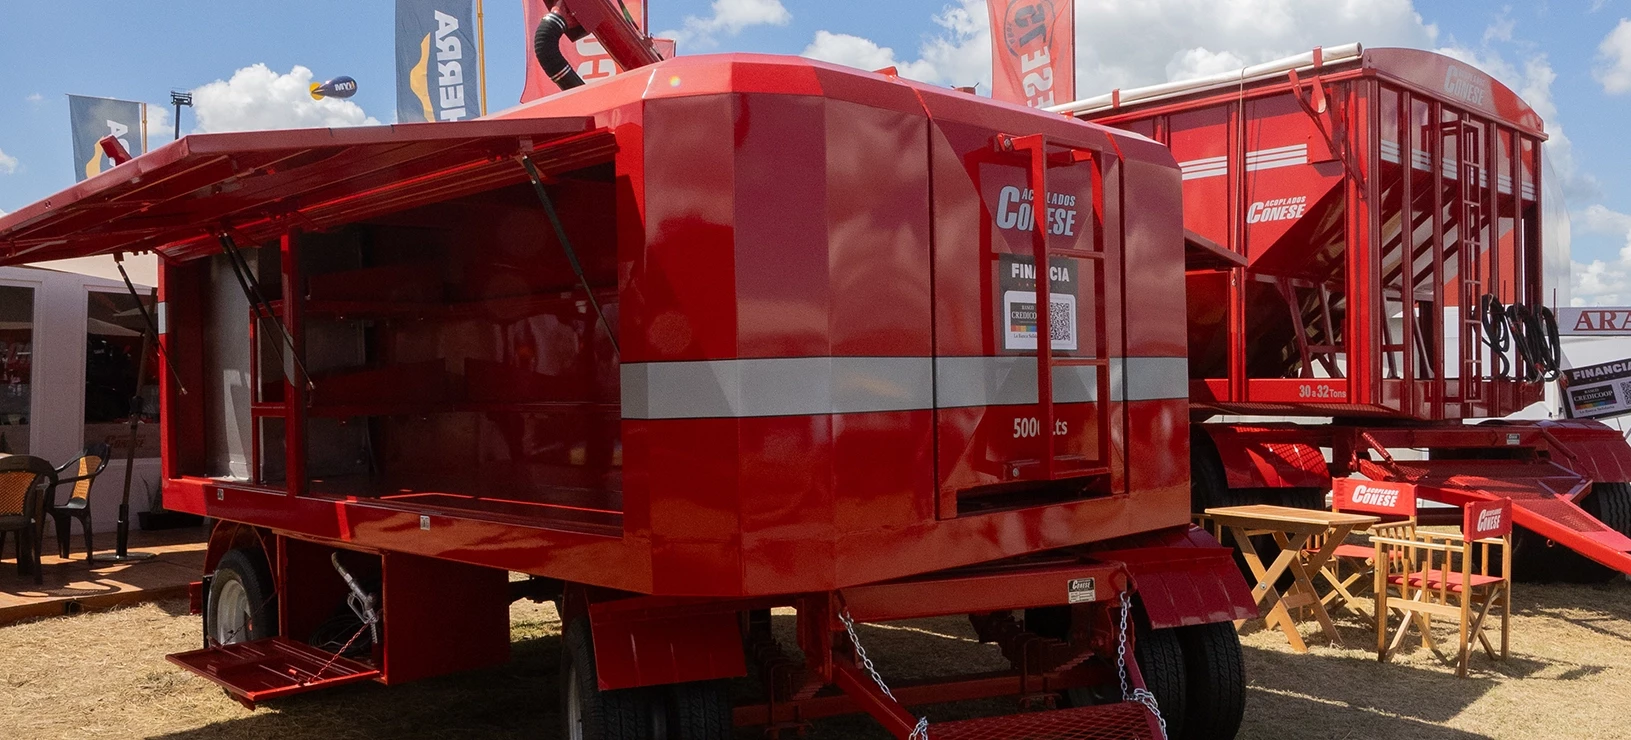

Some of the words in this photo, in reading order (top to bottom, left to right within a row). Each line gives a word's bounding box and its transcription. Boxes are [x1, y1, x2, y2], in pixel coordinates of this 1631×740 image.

[1021, 188, 1076, 207] ACLADOS
[1265, 196, 1306, 207] ACOPLADOS
[996, 185, 1077, 236] COESE
[1246, 201, 1307, 224] CONESE
[1011, 263, 1070, 282] FINCIA
[1299, 384, 1311, 398] 30
[1317, 384, 1329, 398] 32
[1329, 388, 1347, 398] Tons
[1573, 390, 1613, 402] CREDICOOP
[1351, 484, 1398, 507] CONESE
